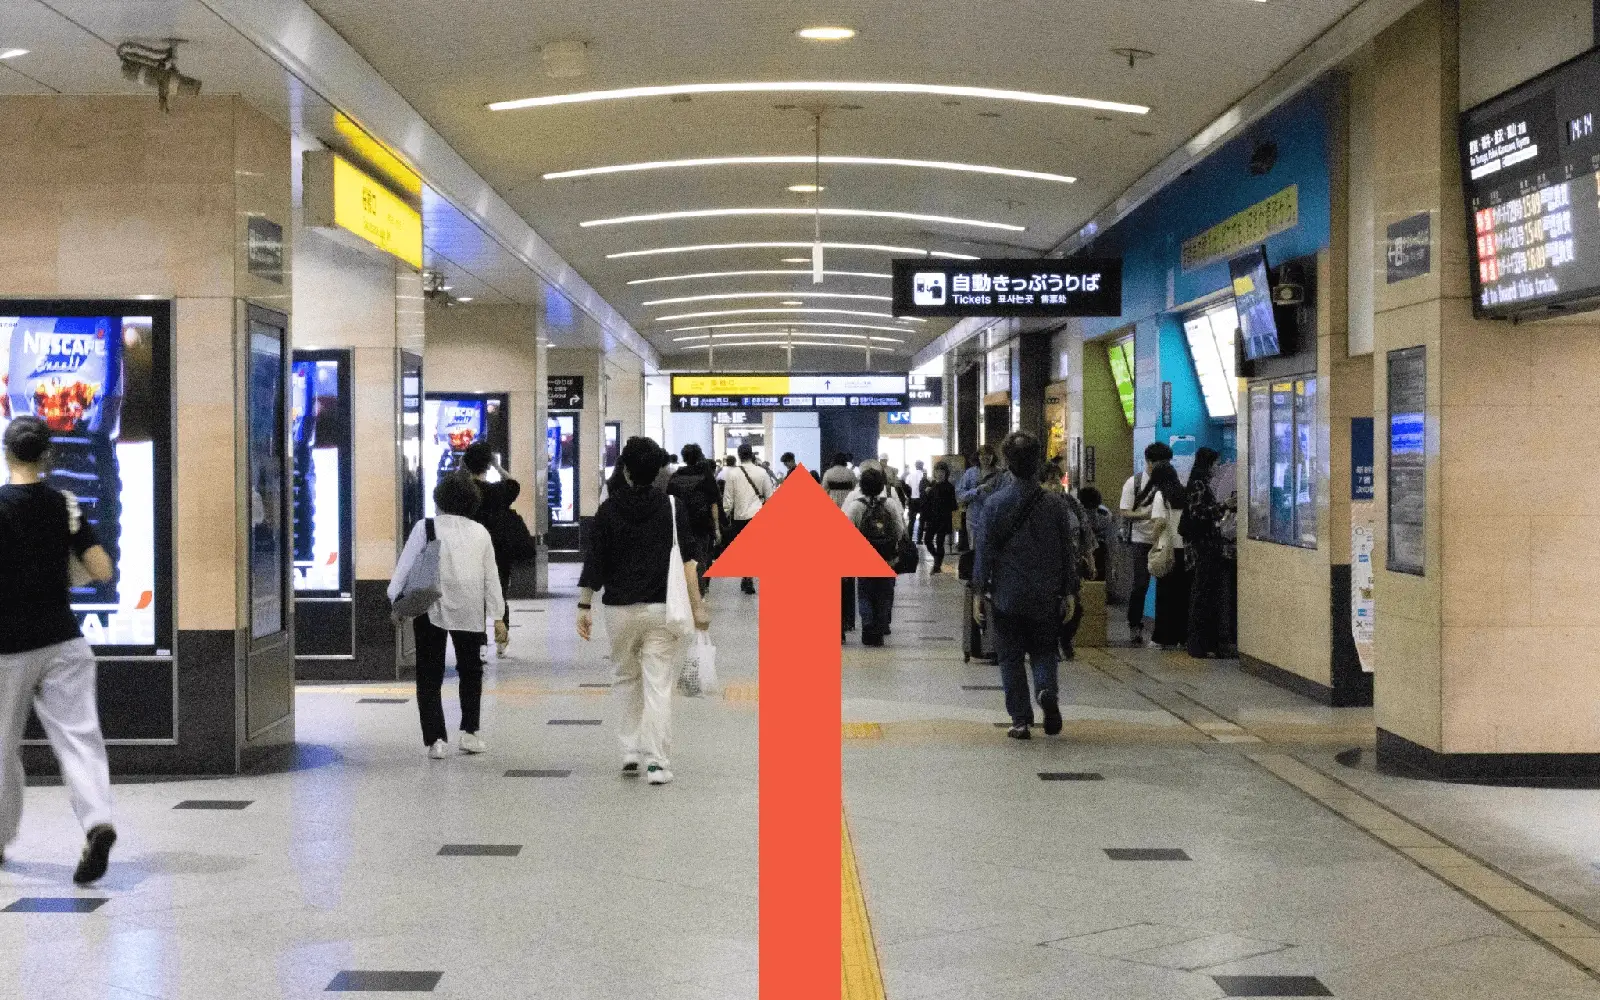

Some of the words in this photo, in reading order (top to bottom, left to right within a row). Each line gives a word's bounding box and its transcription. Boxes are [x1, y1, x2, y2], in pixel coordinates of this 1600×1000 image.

[952, 273, 1101, 292] 自動きっぷうりば
[952, 294, 992, 304] Tickets
